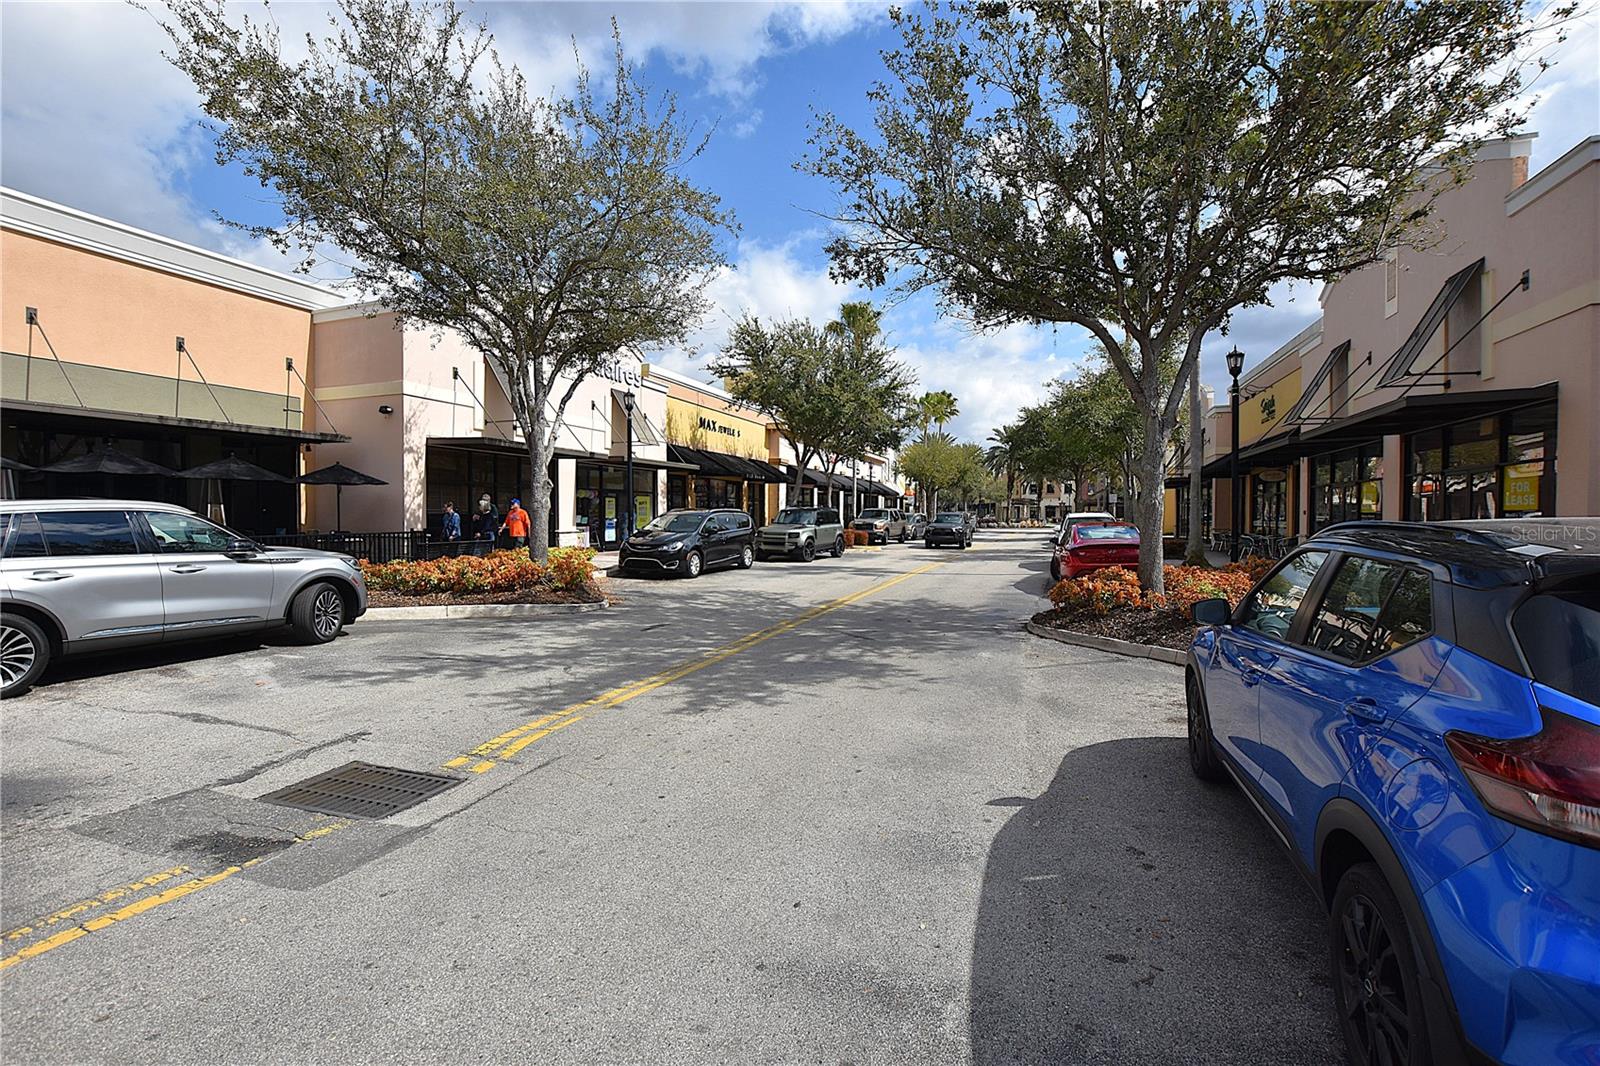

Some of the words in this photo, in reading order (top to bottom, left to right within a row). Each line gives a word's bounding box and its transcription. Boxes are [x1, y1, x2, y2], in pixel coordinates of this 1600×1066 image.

[698, 416, 717, 432] MAX
[1510, 481, 1530, 493] FOR
[1505, 494, 1535, 506] LEASE
